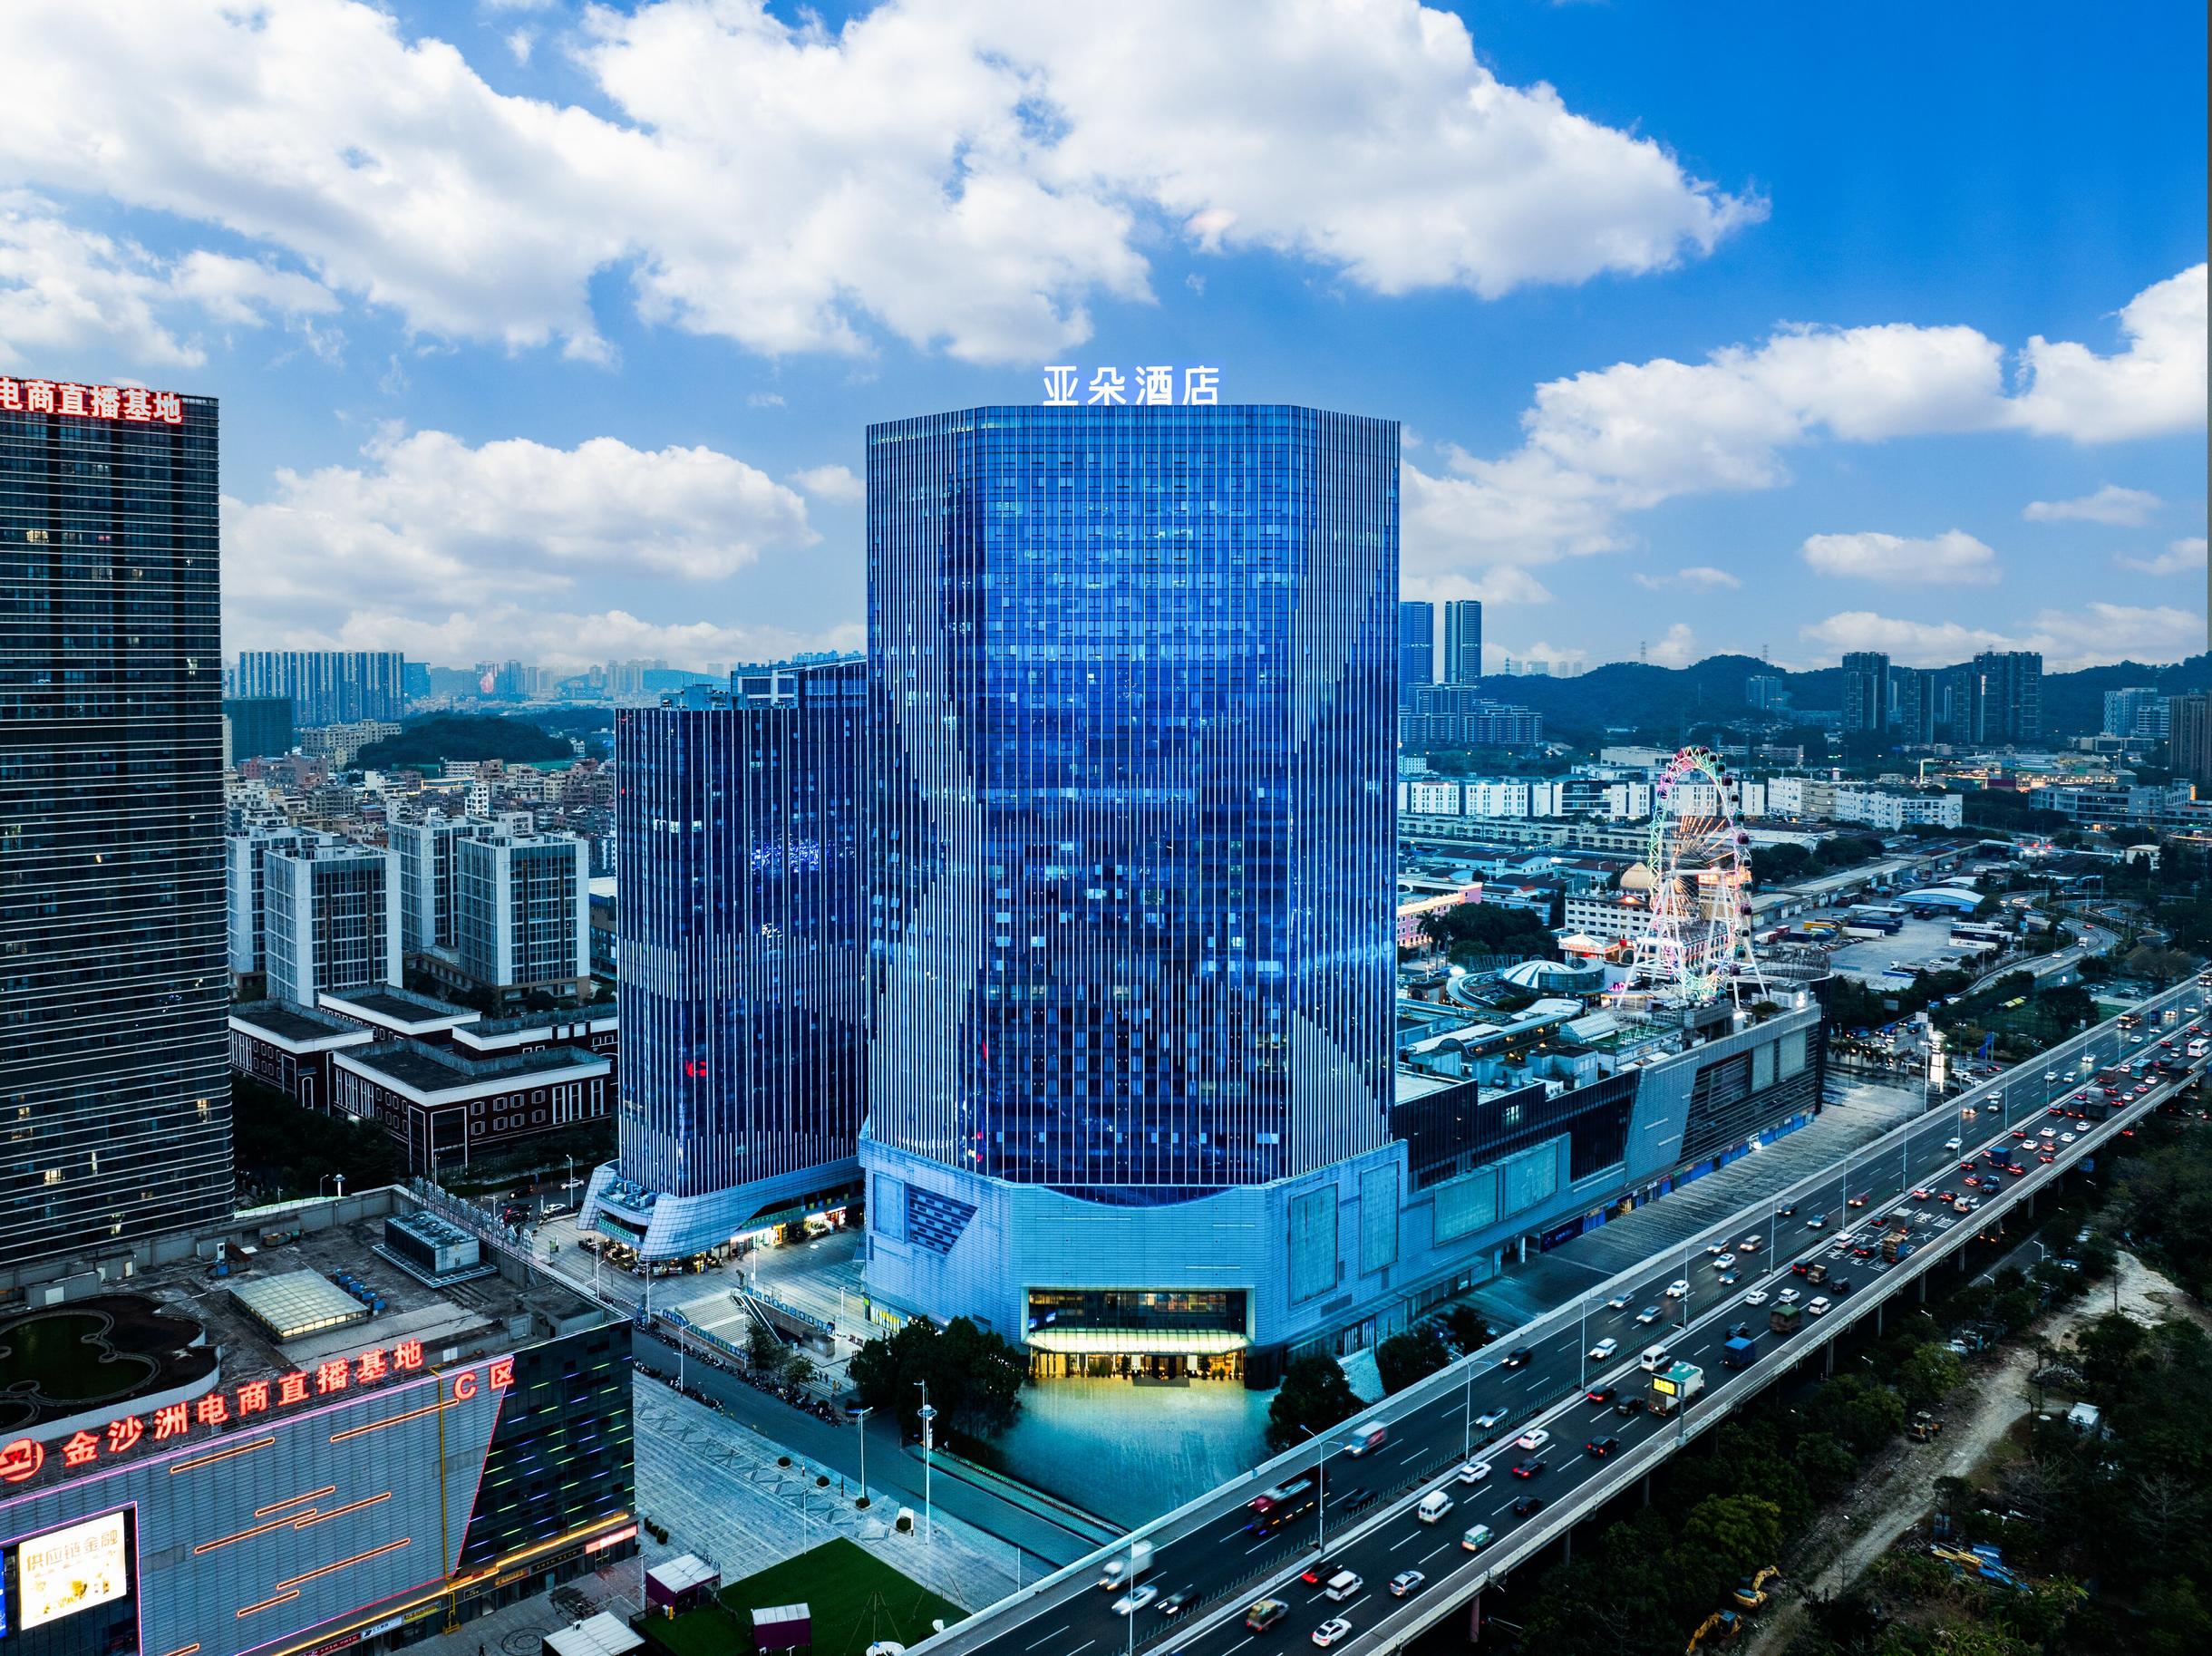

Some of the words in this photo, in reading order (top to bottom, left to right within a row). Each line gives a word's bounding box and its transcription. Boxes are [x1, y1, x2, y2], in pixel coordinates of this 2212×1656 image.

[0, 376, 183, 424] 电商直播基地
[1043, 365, 1219, 406] 亚朵酒店
[62, 1338, 425, 1467] 金沙洲电商直播基地
[453, 1359, 515, 1400] C区
[26, 1529, 119, 1572] 供应链金融
